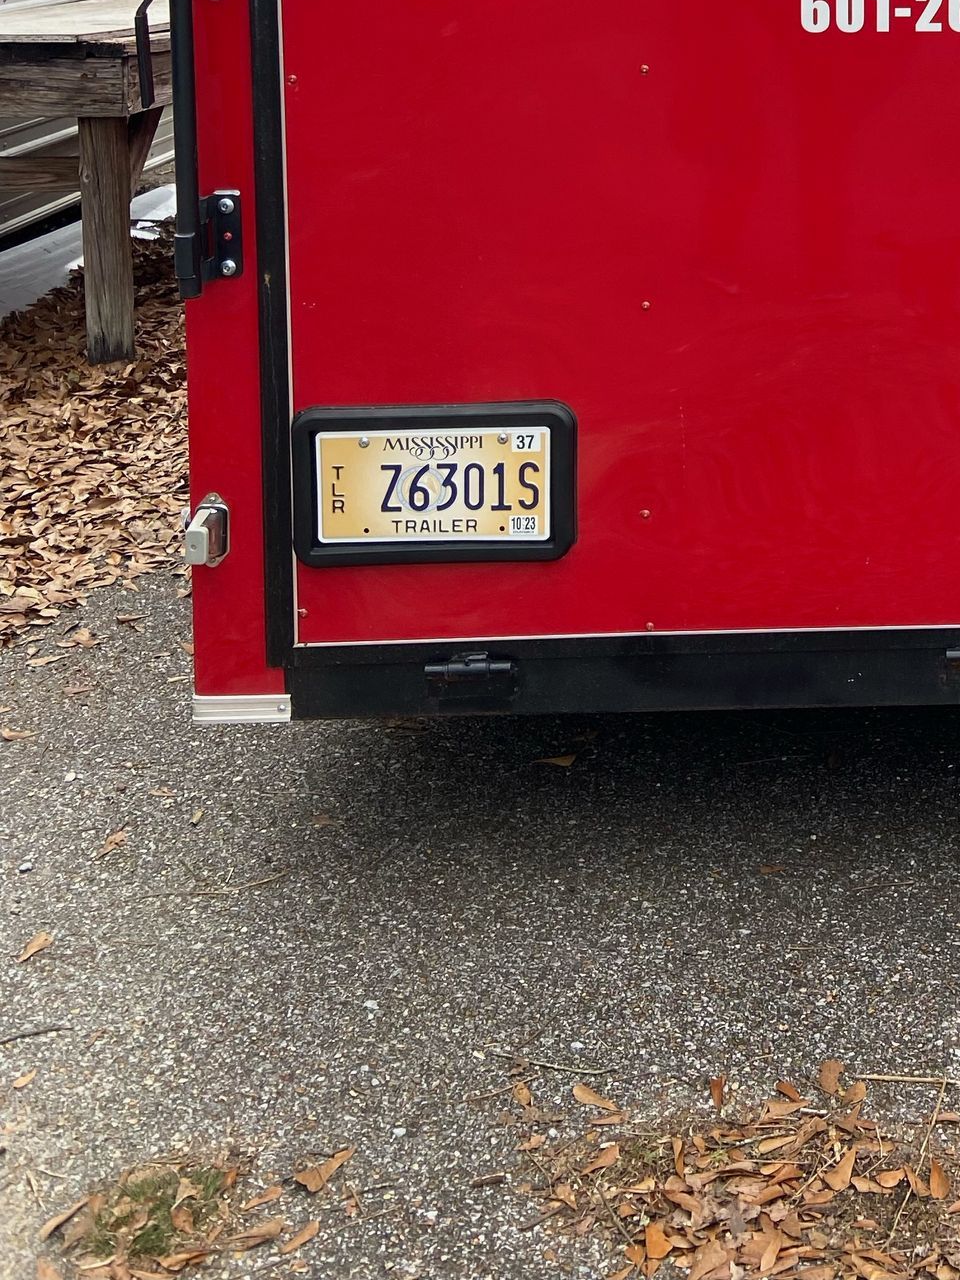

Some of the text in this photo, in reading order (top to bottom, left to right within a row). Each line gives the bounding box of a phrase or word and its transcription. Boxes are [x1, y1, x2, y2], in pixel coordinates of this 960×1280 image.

[383, 435, 483, 461] MISSISSIPPI
[516, 434, 535, 450] 37
[380, 461, 540, 513] Z6301S
[391, 519, 478, 534] TRAILER
